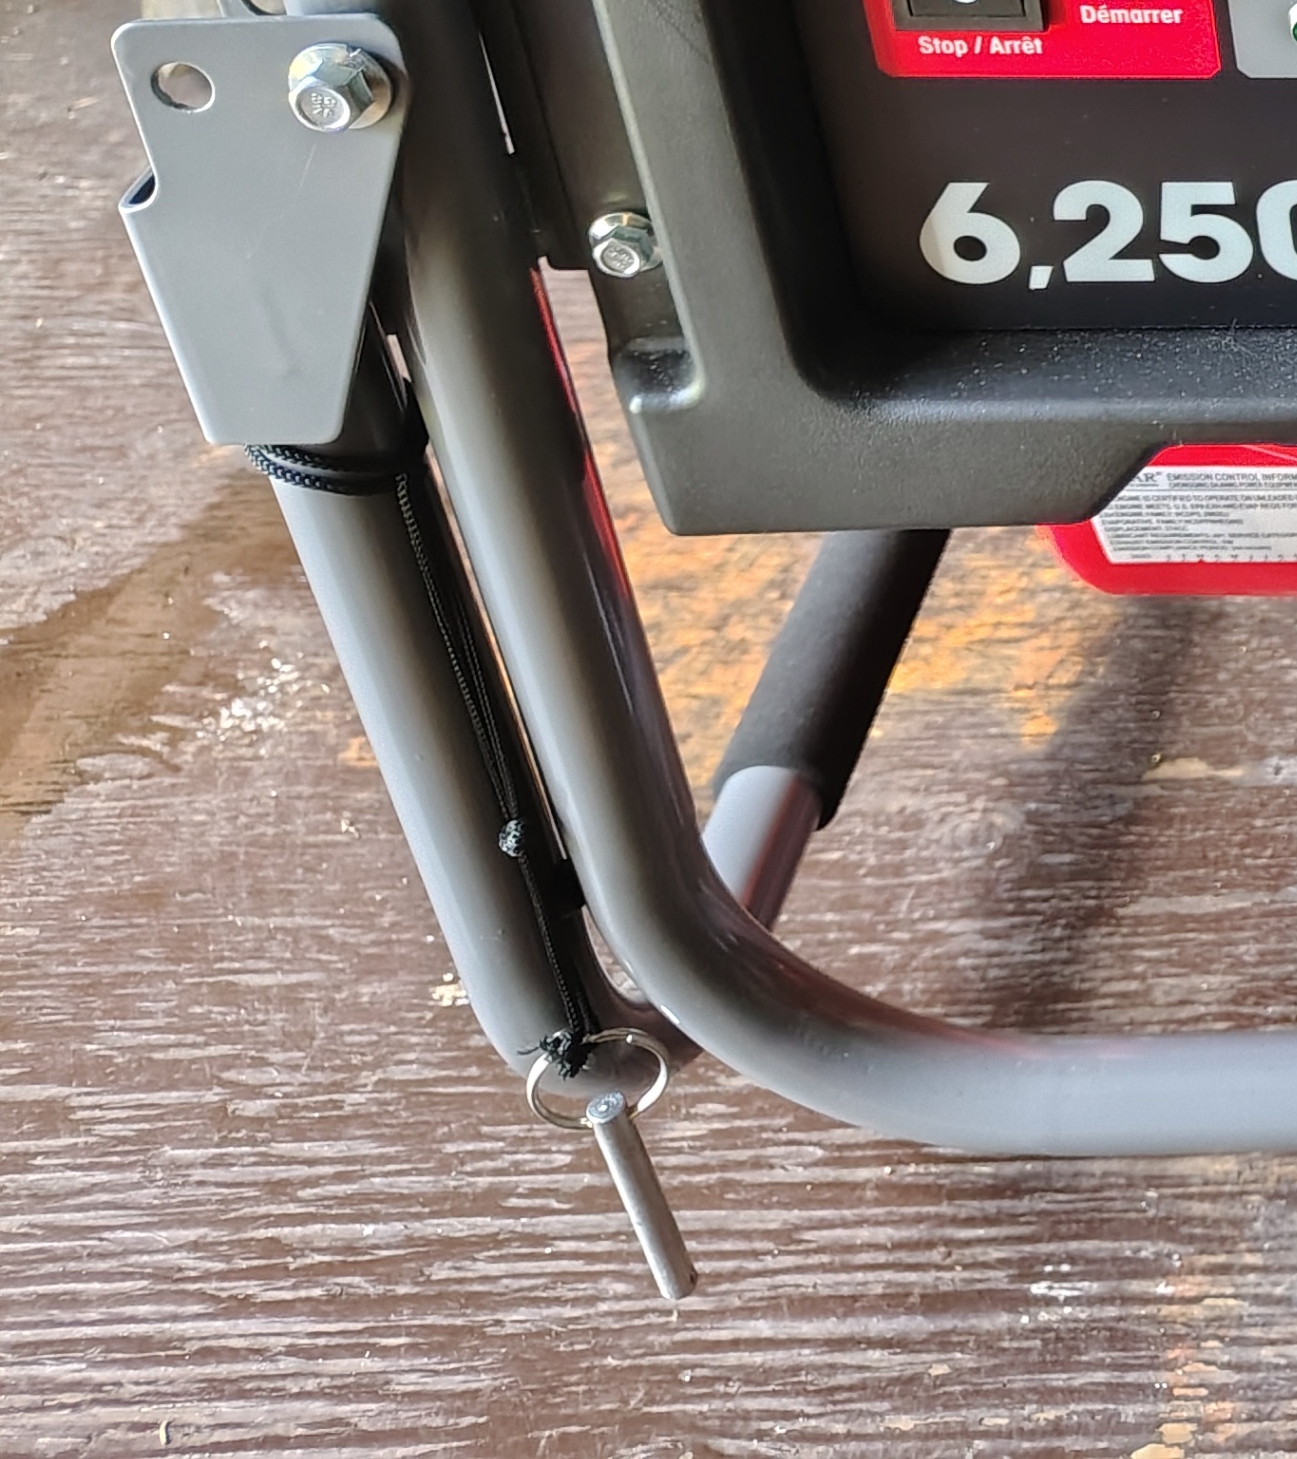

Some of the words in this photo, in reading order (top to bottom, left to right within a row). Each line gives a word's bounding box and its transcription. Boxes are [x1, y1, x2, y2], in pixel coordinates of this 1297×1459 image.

[1080, 3, 1183, 25] Démarrer
[919, 36, 969, 58] Stop
[989, 35, 1043, 55] Arrêt
[1166, 472, 1213, 482] EMISSION
[1214, 472, 1260, 482] CONTROL
